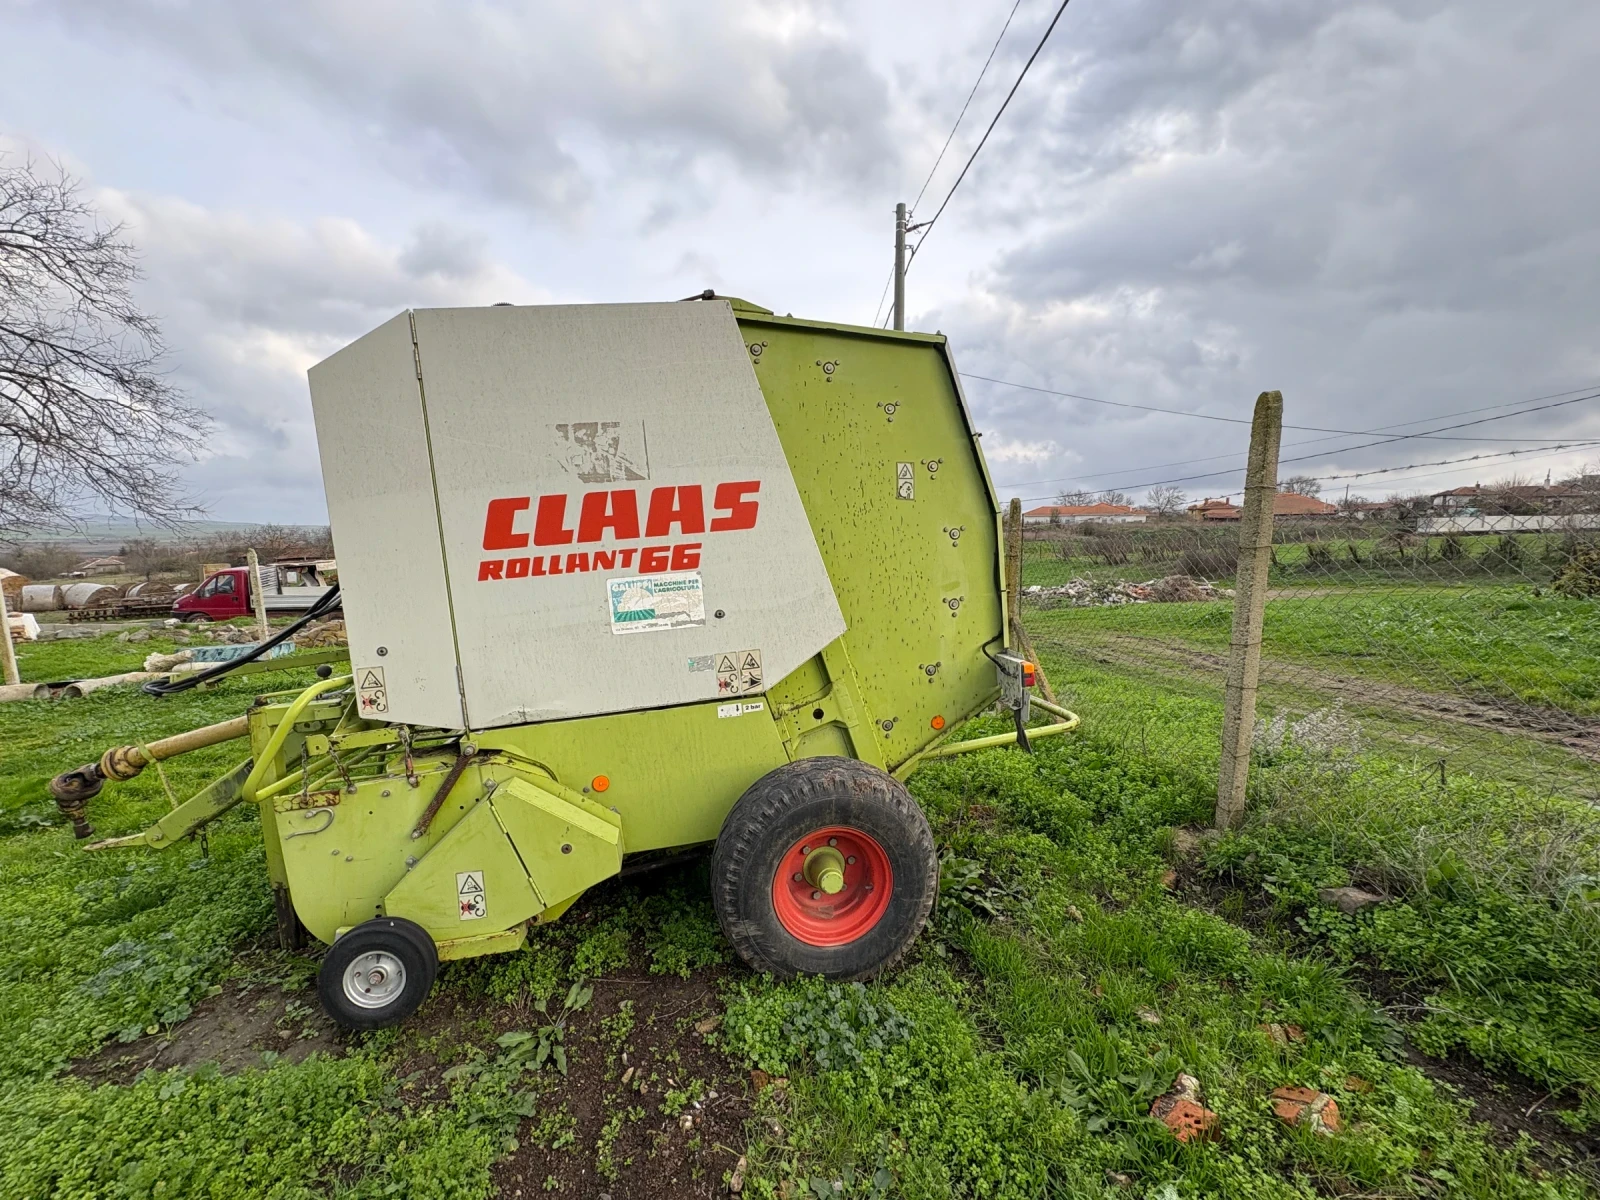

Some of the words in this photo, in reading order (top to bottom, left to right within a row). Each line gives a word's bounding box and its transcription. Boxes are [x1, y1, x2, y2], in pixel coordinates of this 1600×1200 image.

[482, 480, 761, 550] CLAAS
[653, 580, 686, 588] MACCHINE
[653, 585, 700, 594] L'AGRICOLTURA
